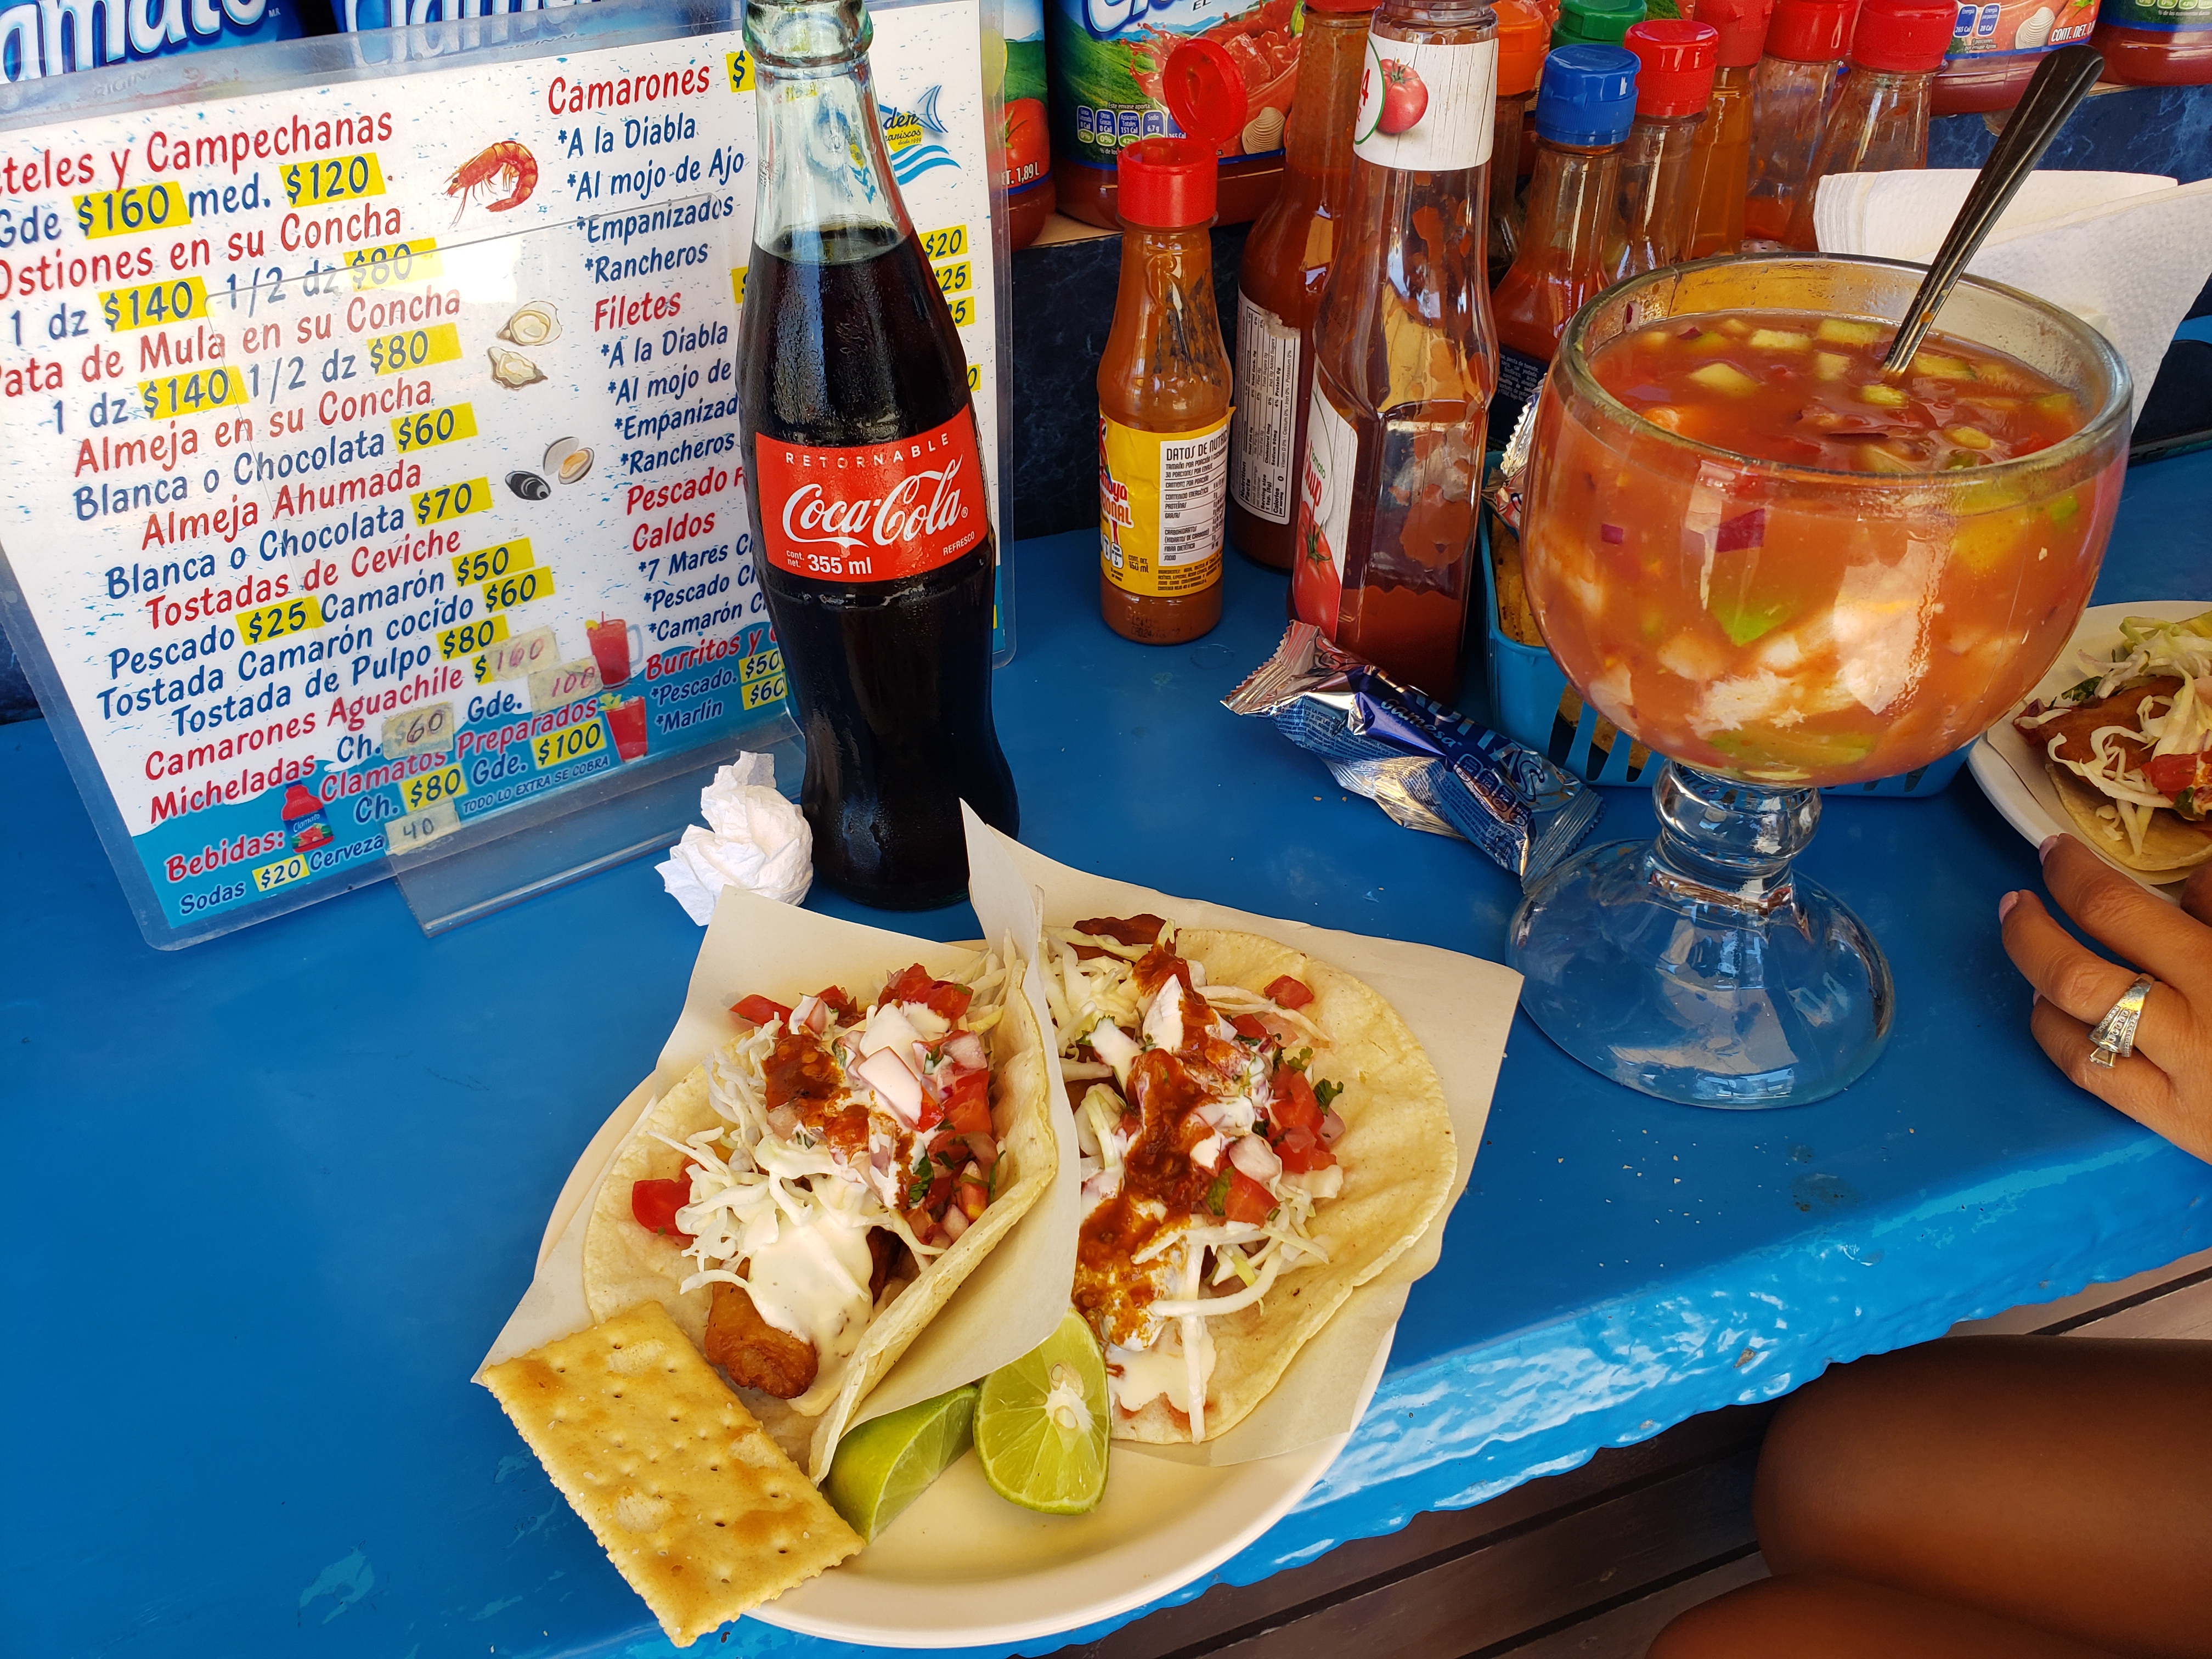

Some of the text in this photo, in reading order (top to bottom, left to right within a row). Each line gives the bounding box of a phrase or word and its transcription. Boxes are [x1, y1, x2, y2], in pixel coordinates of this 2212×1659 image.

[2051, 24, 2087, 42] CONT. NET.
[549, 66, 710, 115] Camarones
[0, 111, 392, 195] teles y Campechanas
[595, 126, 613, 154] la
[625, 112, 696, 149] Diabla
[611, 160, 665, 201] mojo
[675, 156, 700, 182] de
[709, 148, 744, 185] Ajo
[0, 156, 369, 247] Gde $160 med. $120
[171, 238, 209, 269] en
[228, 229, 264, 261] su
[281, 203, 400, 250] Concha
[926, 229, 961, 258] $20
[11, 242, 412, 346] 1 dz $140 1/2 dz $80
[935, 264, 966, 292] 25
[82, 343, 123, 383] de
[140, 325, 225, 373] Mula
[242, 322, 280, 354] en
[297, 312, 331, 345] su
[347, 285, 460, 334] Concha
[595, 291, 681, 331] Filetes
[634, 337, 652, 362] la
[663, 322, 727, 356] Diabla
[55, 331, 428, 434] 1 dz $140 1/2 dz $80
[647, 369, 699, 400] mojo
[708, 360, 732, 382] de
[75, 378, 430, 477] Almeja en su Concha
[786, 433, 949, 469] RETORNABLE
[1166, 443, 1207, 461] DATOS DE
[72, 409, 454, 522] Blanca o Chocolata $60
[142, 461, 421, 550] Almeja Ahumada
[627, 470, 727, 516] Pescado
[105, 487, 472, 599] Blanca o Chocolata $70
[632, 512, 715, 553] Caldos
[786, 550, 805, 561] cont.
[943, 531, 975, 556] REFRESCO
[145, 531, 461, 630] Tostadas de Ceviche
[669, 545, 727, 575] Mares
[787, 558, 801, 568] net.
[808, 554, 872, 574] 355 ml
[1129, 562, 1138, 571] 150
[110, 548, 509, 680] Pescado $25 Camarón $50
[97, 575, 537, 719] Tostada Camarón cocido $60
[645, 635, 740, 681] Burritos
[749, 631, 763, 654] y
[746, 651, 780, 679] $50
[171, 621, 494, 736] Tostada de Pulpo $80
[751, 677, 785, 705] $60
[145, 712, 316, 780] Camarones
[328, 664, 464, 731] Aguachile
[319, 696, 597, 801] Clamatos Preparados
[337, 733, 381, 763] Ch.
[467, 691, 522, 723] Gde.
[150, 754, 316, 824] Micheladas
[356, 724, 601, 823] Ch. $80 Gde. $100
[463, 757, 609, 813] TODO LO EXTRA SE COBRA
[294, 814, 320, 833] Clamato
[165, 830, 285, 883] Bebidas:
[180, 881, 246, 915] Sodas
[260, 859, 301, 889] $20
[310, 834, 383, 872] Cerveza
